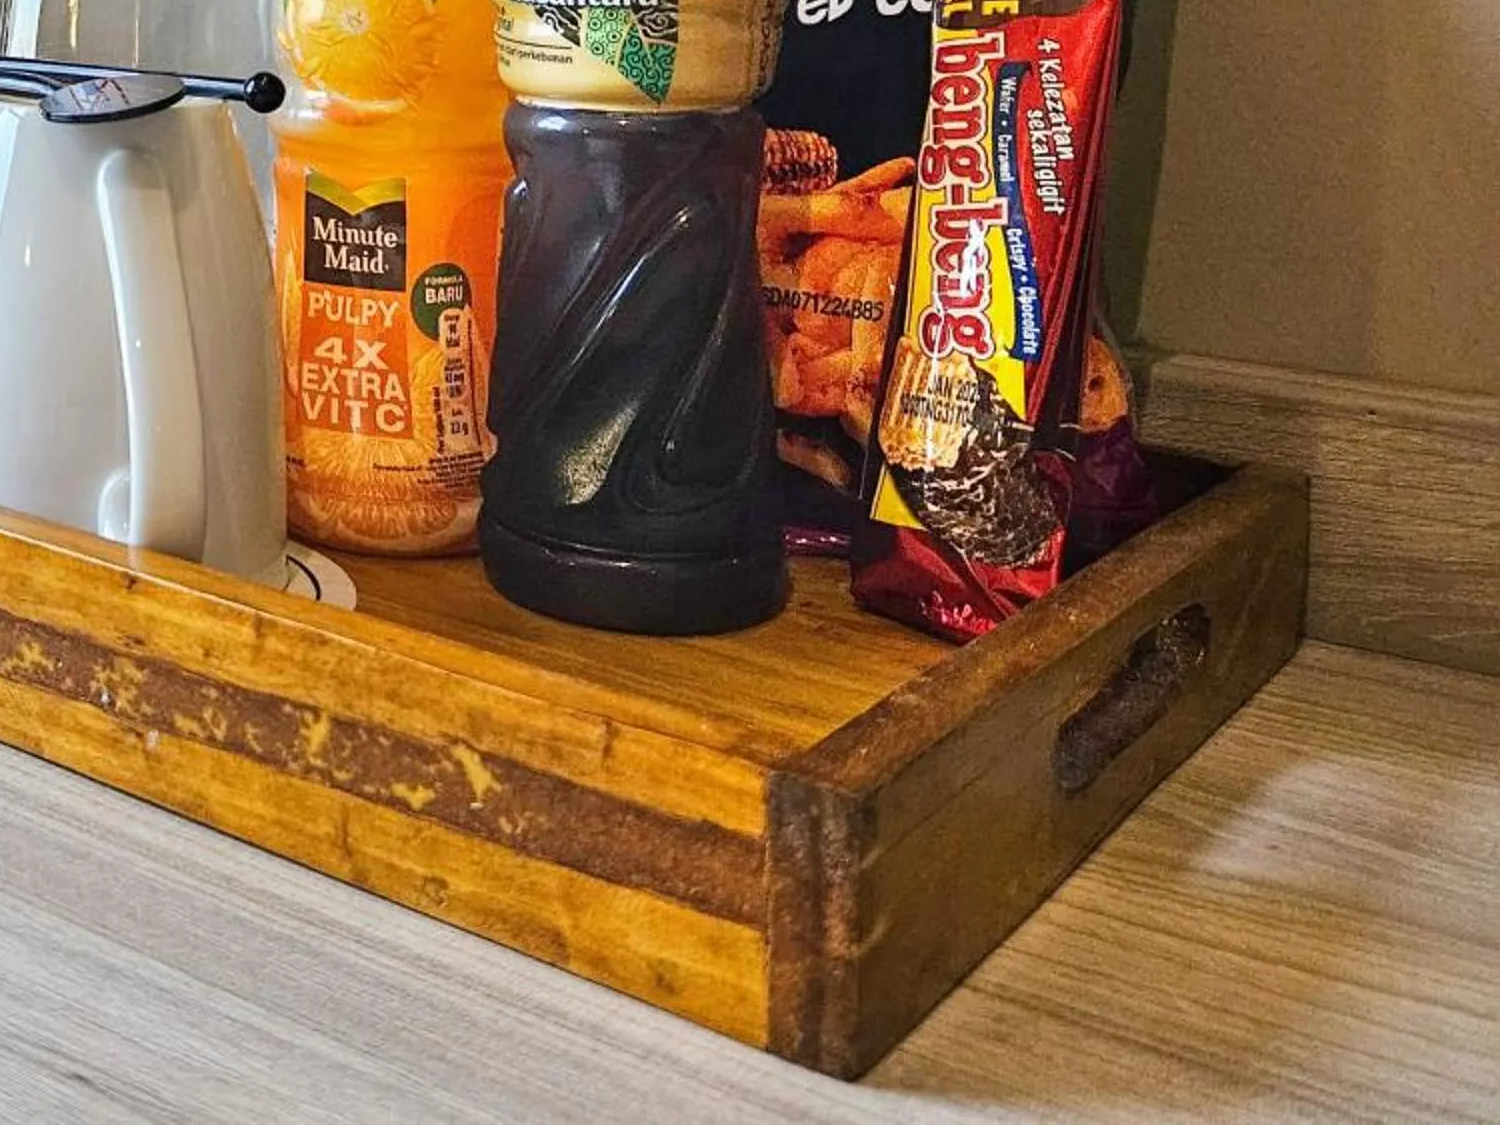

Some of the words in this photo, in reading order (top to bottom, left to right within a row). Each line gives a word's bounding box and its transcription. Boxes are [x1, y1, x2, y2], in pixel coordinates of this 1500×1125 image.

[1038, 38, 1059, 53] 4
[999, 76, 1017, 114] Wafer
[1038, 58, 1076, 161] Kelezatan
[998, 133, 1016, 183] Caramel
[916, 29, 1011, 360] beng-beng
[311, 216, 398, 249] Minute
[1006, 227, 1030, 271] Crispy
[324, 243, 385, 274] Maid
[307, 290, 400, 329] PULPY
[424, 285, 464, 305] BARU
[1017, 286, 1042, 356] Chocolate
[302, 362, 406, 403] EXTRA
